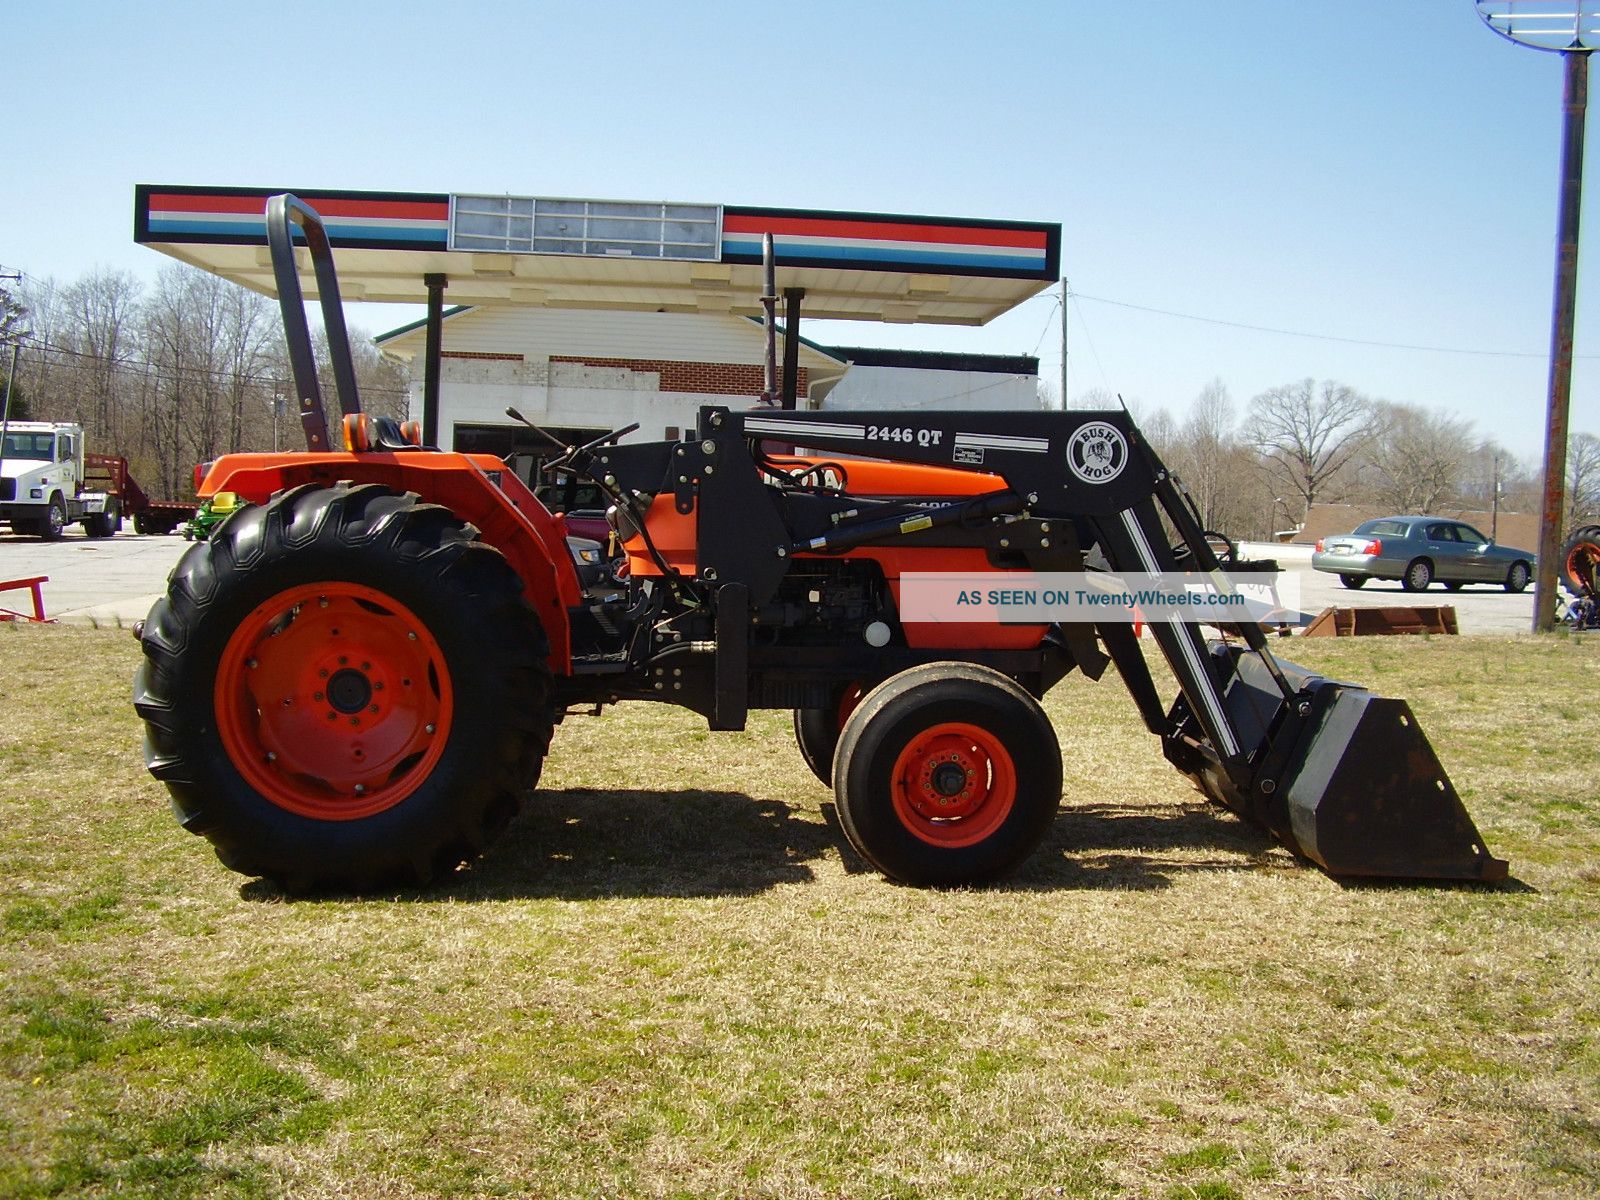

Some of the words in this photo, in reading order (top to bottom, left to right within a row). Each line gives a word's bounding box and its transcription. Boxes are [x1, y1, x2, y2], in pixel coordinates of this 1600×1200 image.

[867, 425, 913, 442] 2446
[917, 429, 943, 447] QT
[1080, 428, 1115, 443] BUSH
[1082, 465, 1112, 478] HOG
